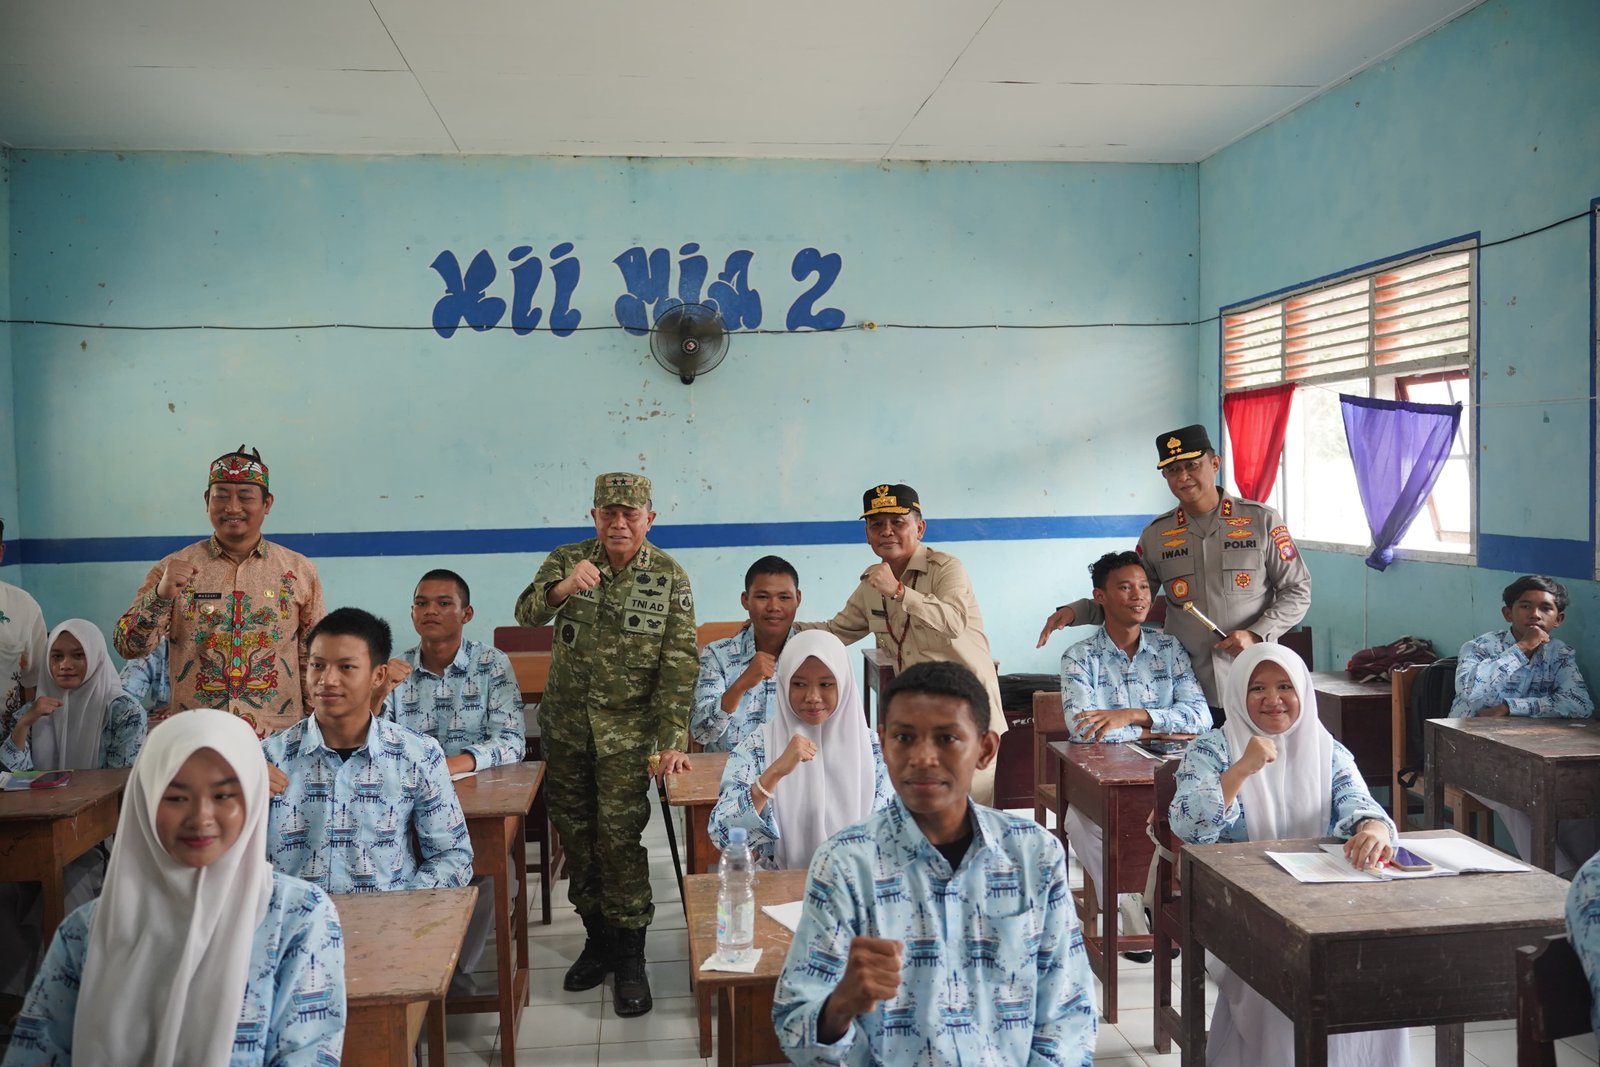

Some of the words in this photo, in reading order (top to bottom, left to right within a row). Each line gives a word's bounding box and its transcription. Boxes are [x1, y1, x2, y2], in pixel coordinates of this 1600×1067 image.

[785, 247, 846, 332] 2
[1224, 540, 1257, 550] POLRI
[1161, 548, 1189, 560] IWAN
[576, 589, 595, 600] NUL
[632, 599, 648, 609] TNI
[649, 601, 665, 612] AD
